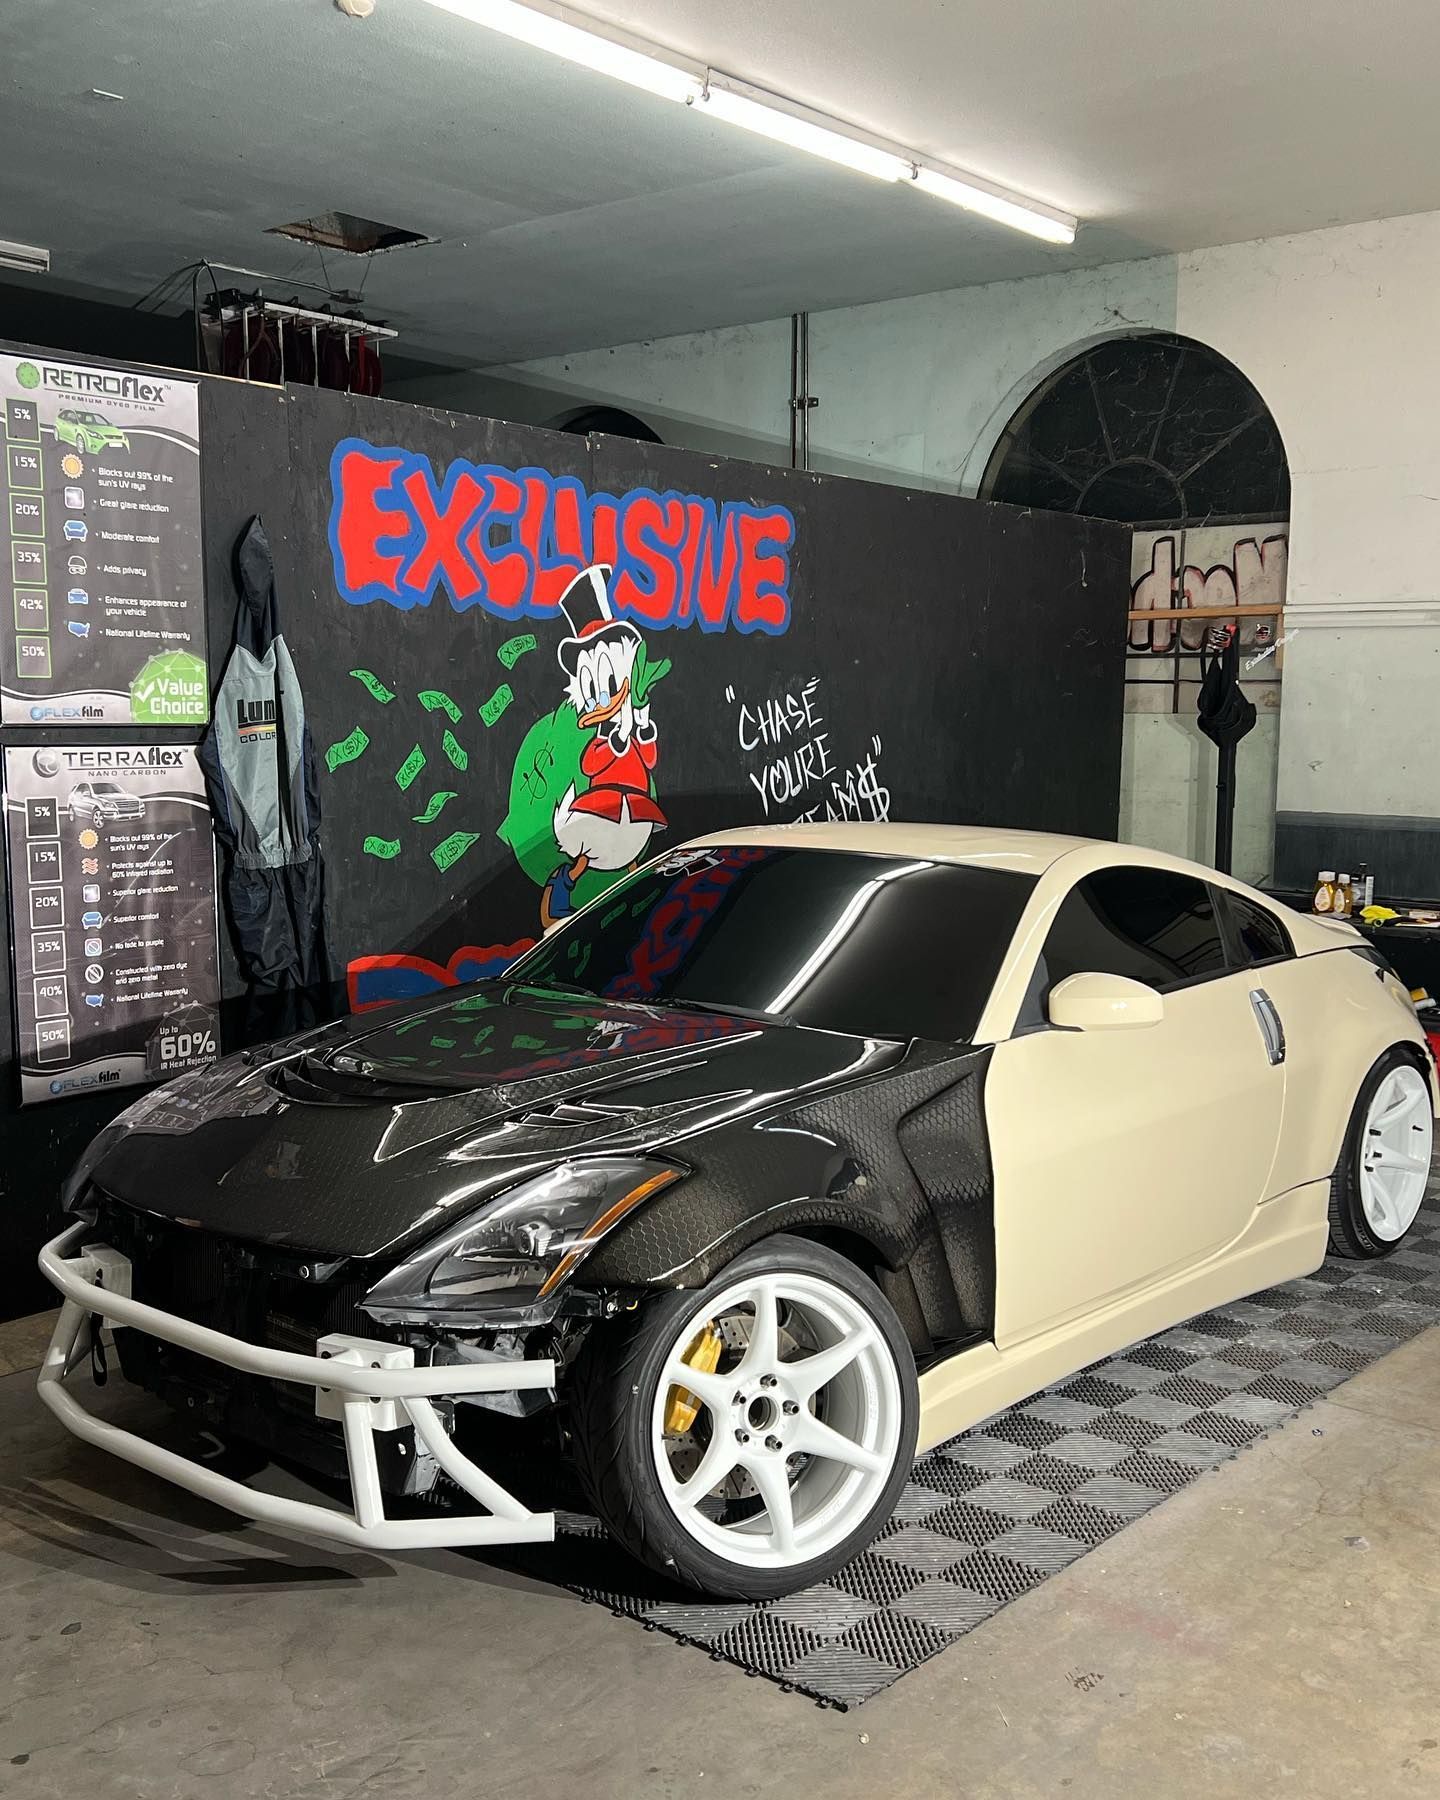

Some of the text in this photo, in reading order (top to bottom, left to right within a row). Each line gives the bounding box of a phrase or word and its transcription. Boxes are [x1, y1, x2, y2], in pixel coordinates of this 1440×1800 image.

[58, 394, 102, 404] PREMIUM
[14, 407, 31, 420] 5%
[15, 456, 37, 468] 15%
[98, 467, 123, 478] Blocks
[124, 471, 136, 479] out
[137, 471, 152, 480] 99%
[161, 474, 174, 483] the
[98, 479, 146, 491] sun's UV rays
[15, 504, 39, 516] 20%
[99, 498, 170, 512] Great glare reduction
[101, 531, 160, 543] Moderate comfort
[330, 438, 795, 636] EXCLUSIVE
[17, 551, 41, 563] 35%
[103, 564, 147, 577] Adds privacy
[19, 598, 43, 610] 42%
[104, 595, 138, 606] Enhances
[139, 599, 179, 608] appearance
[105, 608, 147, 617] your vehicle
[105, 628, 191, 641] National Lifetime Warranty
[22, 646, 45, 657] 50%
[157, 678, 204, 697] Value
[151, 697, 205, 715] Choice
[34, 806, 51, 817] 5%
[110, 835, 130, 843] Blocks
[110, 844, 126, 852] sun's
[35, 851, 56, 863] 15%
[111, 862, 134, 870] Protects
[112, 889, 136, 897] Superior
[153, 885, 179, 893] reduction
[35, 895, 58, 907] 20%
[113, 913, 160, 924] Superior comfort
[37, 941, 60, 952] 35%
[115, 942, 124, 950] No
[145, 939, 164, 947] purple
[115, 966, 149, 976] Constructed
[163, 963, 176, 971] zero
[128, 976, 141, 984] zero
[141, 974, 159, 982] metal
[39, 985, 63, 997] 40%
[116, 988, 189, 1003] National Lifetime Warranty
[41, 1029, 65, 1041] 50%
[159, 1025, 179, 1036] Up to
[161, 1030, 216, 1060] 60%
[160, 1055, 217, 1070] IR Heat Rejection
